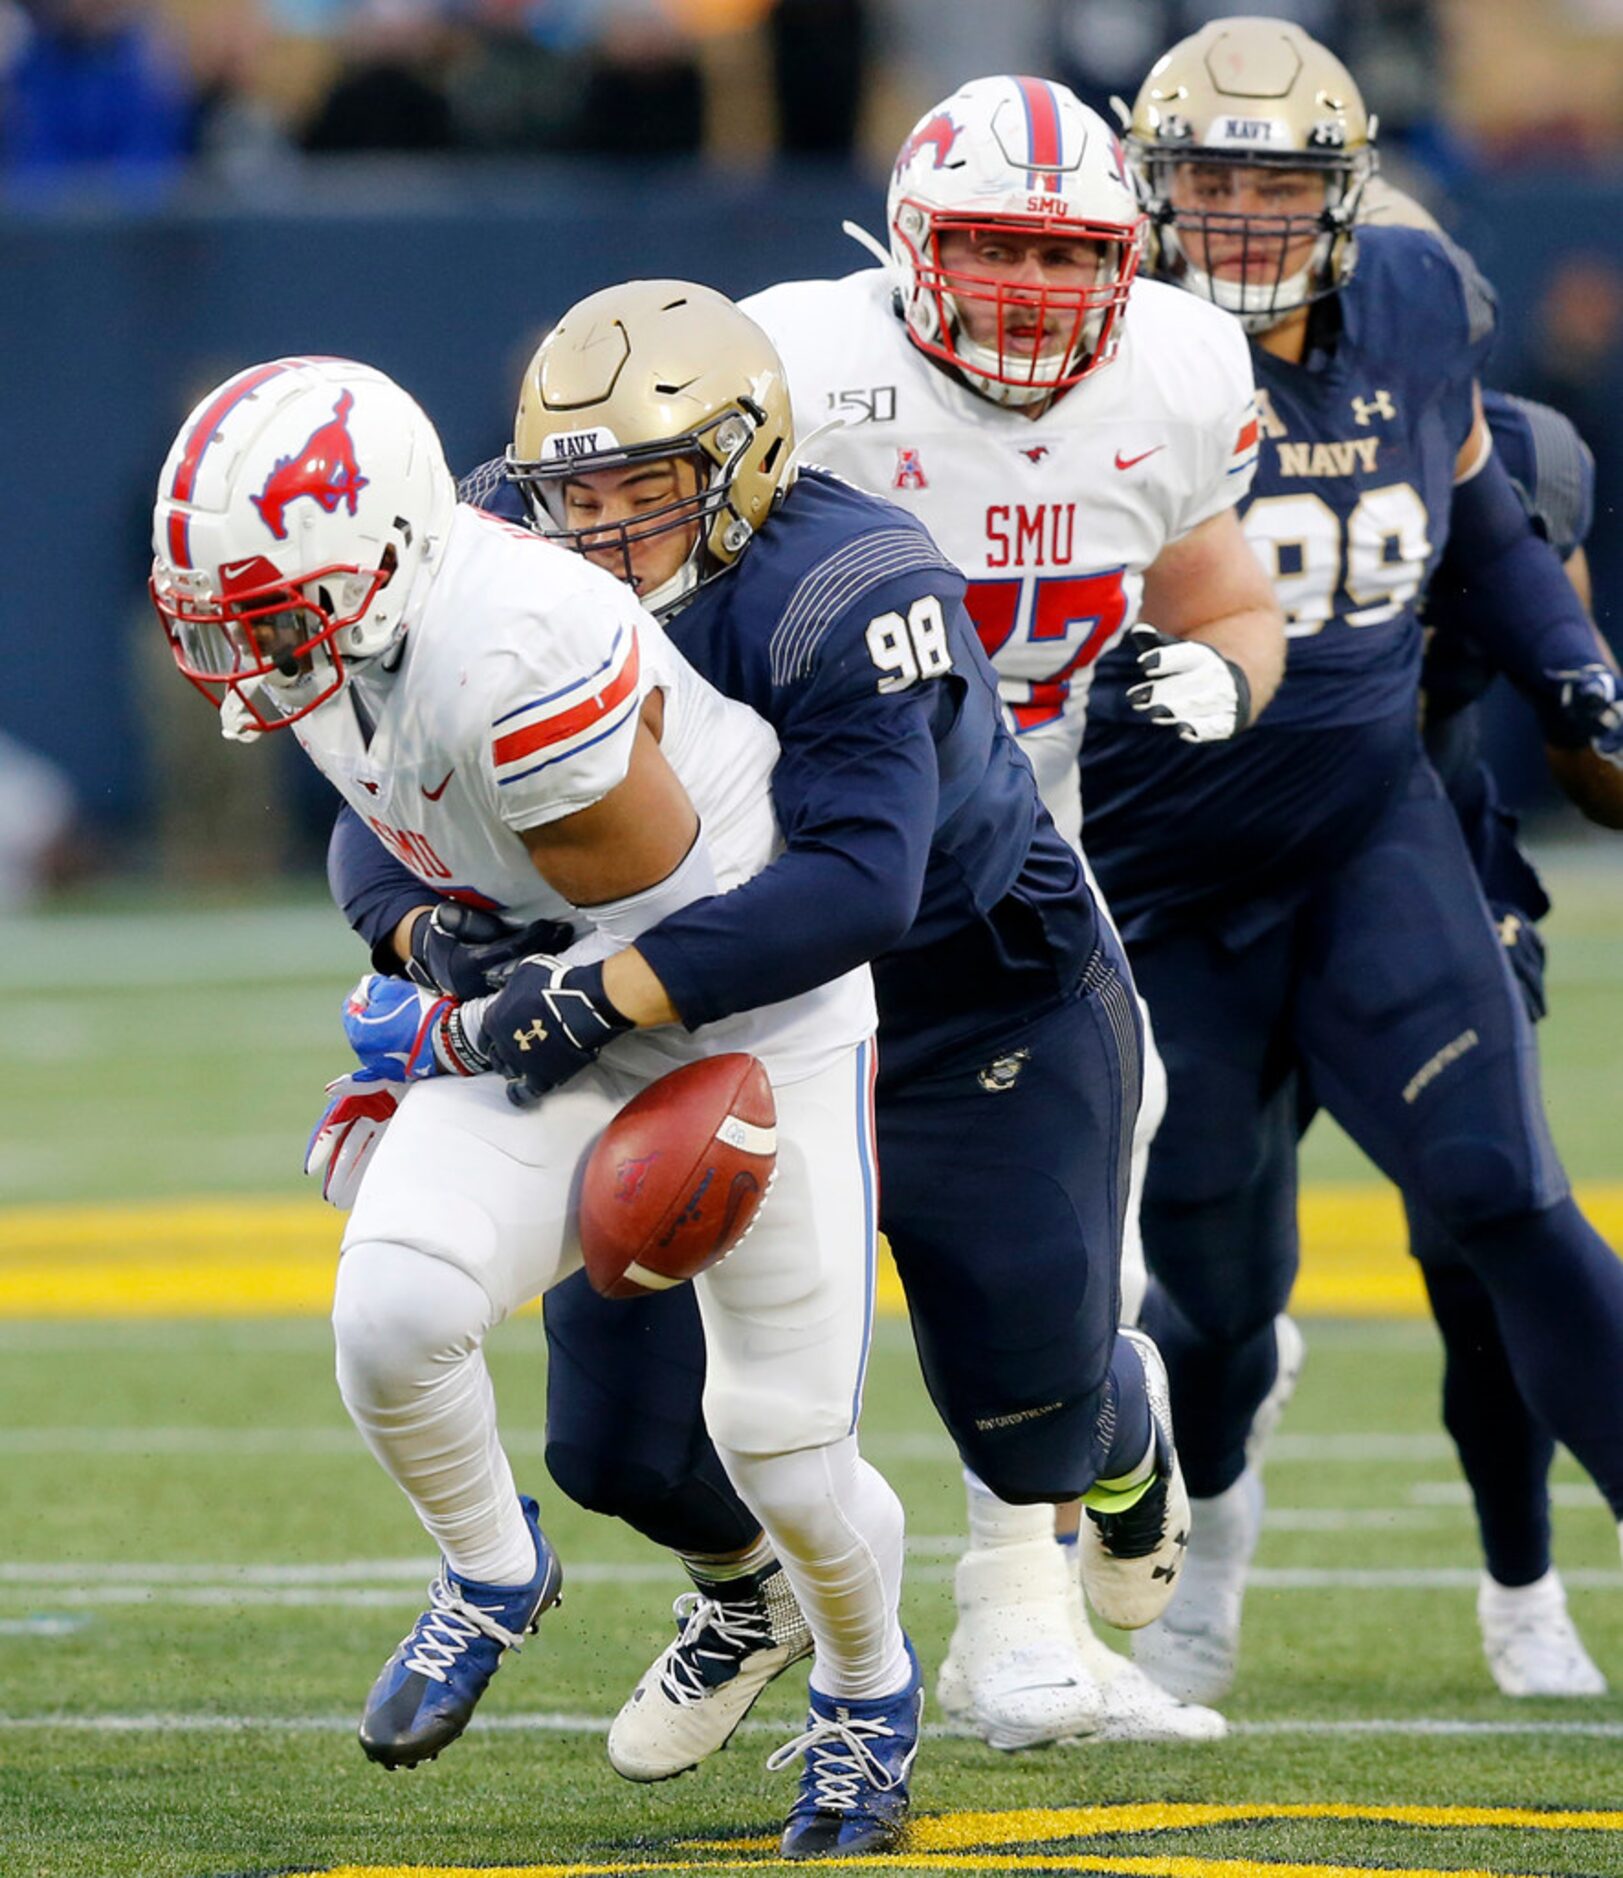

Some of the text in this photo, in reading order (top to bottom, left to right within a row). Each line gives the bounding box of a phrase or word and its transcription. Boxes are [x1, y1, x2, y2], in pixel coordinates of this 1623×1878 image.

[1225, 120, 1271, 141] NAVY
[1026, 196, 1068, 217] SMU
[554, 432, 597, 458] NAVY
[1276, 436, 1380, 477] NAVY
[986, 503, 1076, 568] SMU
[1243, 481, 1433, 638] 99
[864, 594, 953, 694] 98
[368, 815, 453, 879] SMU
